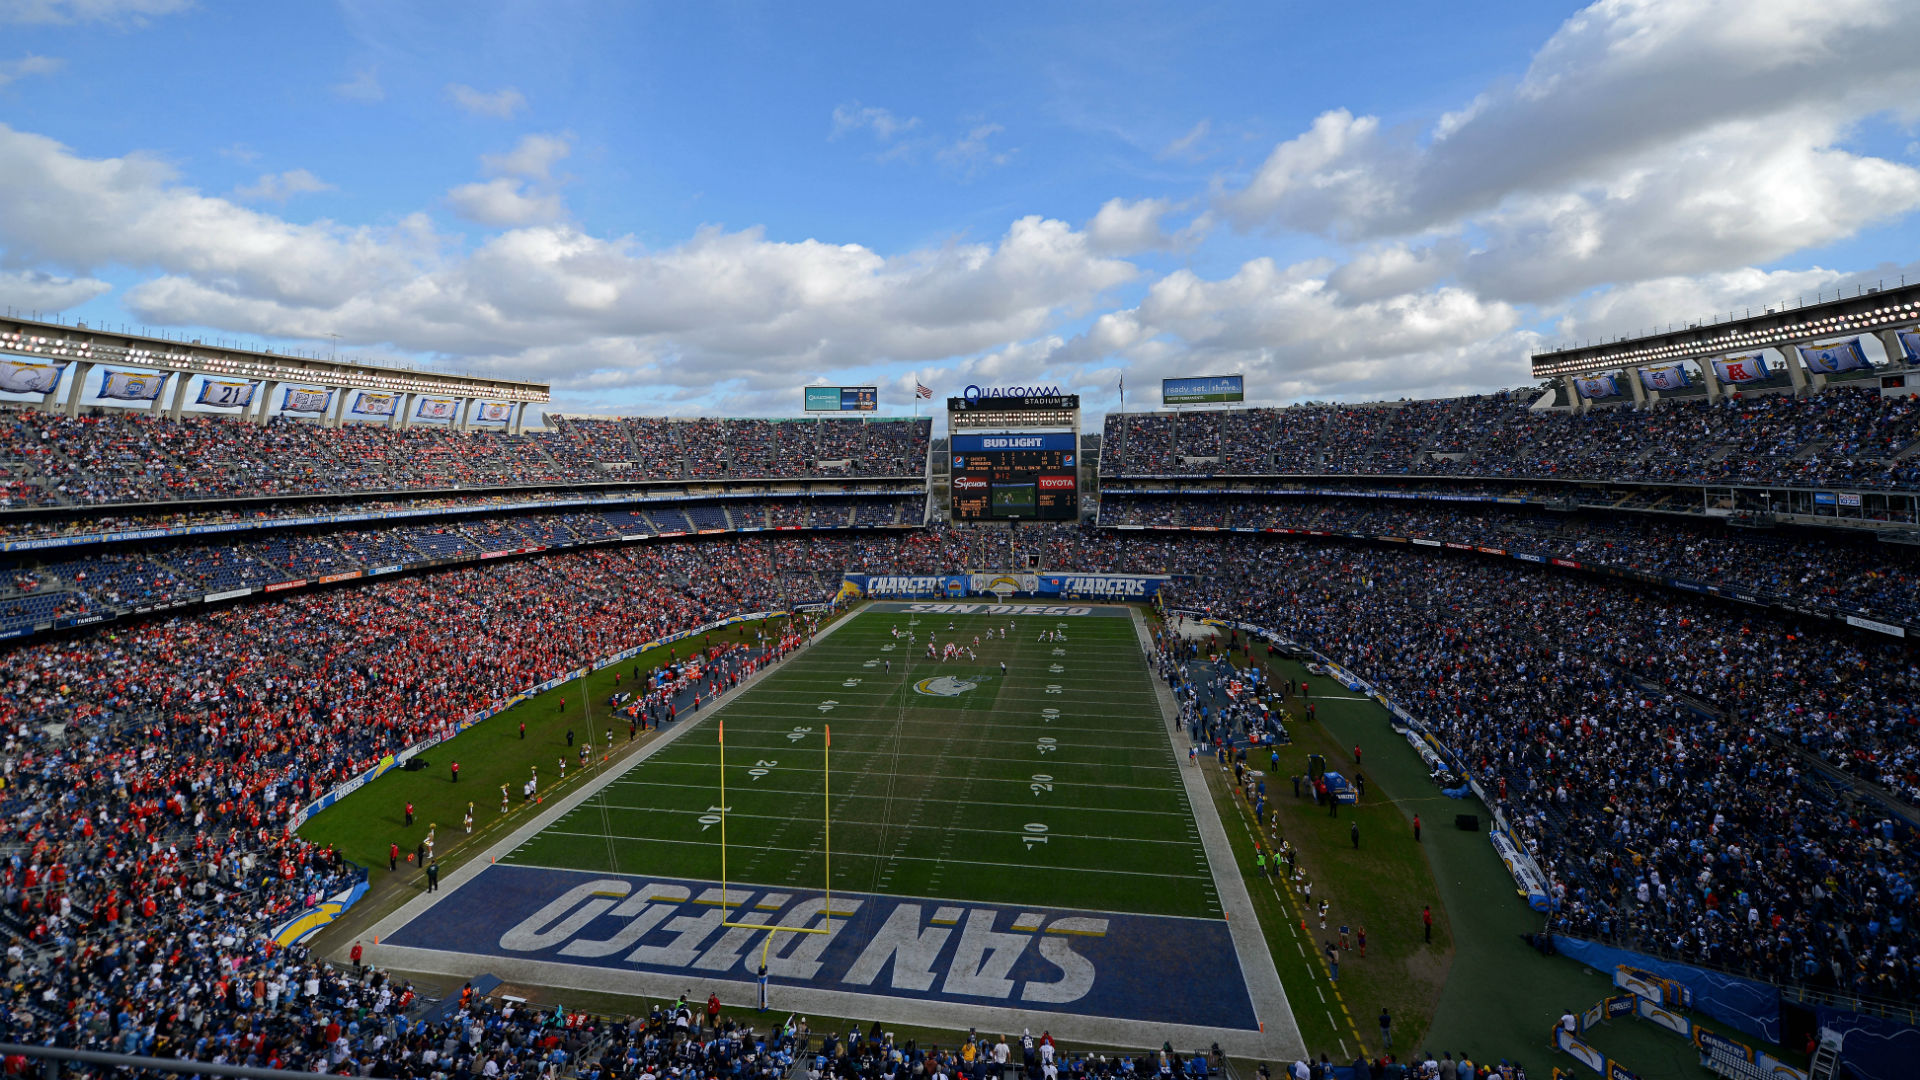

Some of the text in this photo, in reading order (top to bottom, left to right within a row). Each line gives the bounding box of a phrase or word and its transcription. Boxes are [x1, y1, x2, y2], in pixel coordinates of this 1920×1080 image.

[219, 386, 240, 403] 21
[984, 438, 1042, 448] BUD LIGHT
[954, 477, 988, 490] Sycuan
[1041, 479, 1074, 487] TOYOTA
[31, 540, 68, 548] GILLMAN
[267, 582, 293, 591] TOSHIBA
[868, 577, 946, 594] CHARGERS
[1064, 577, 1146, 596] CHARGERS
[902, 604, 1093, 616] SAN DIEGO
[77, 615, 104, 624] FANDUEL
[1045, 685, 1062, 694] 50
[1042, 708, 1060, 720] 40
[786, 726, 812, 739] 30
[1036, 737, 1057, 751] 30
[748, 760, 778, 776] 20
[1030, 774, 1053, 791] 20
[698, 805, 732, 824] 10
[1022, 823, 1048, 844] 10
[500, 879, 1110, 1004] SAN DIEGO
[1701, 1034, 1745, 1058] CHARGERS
